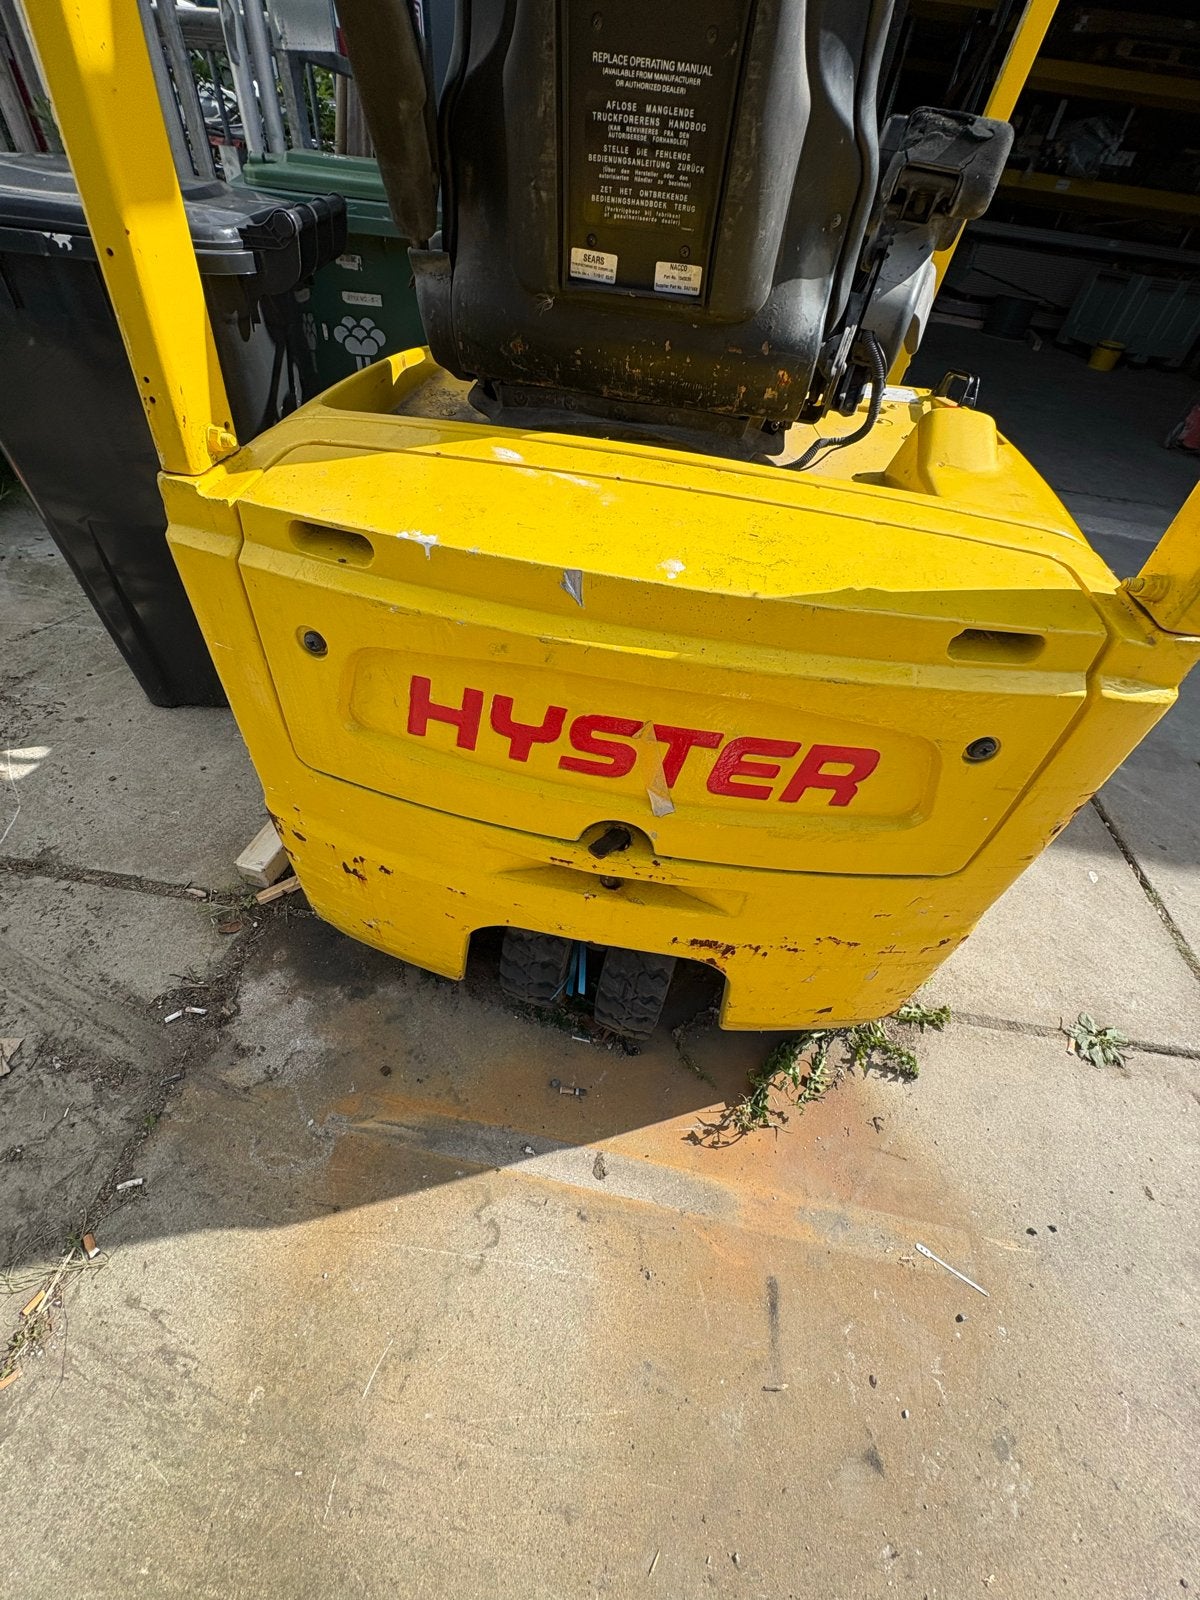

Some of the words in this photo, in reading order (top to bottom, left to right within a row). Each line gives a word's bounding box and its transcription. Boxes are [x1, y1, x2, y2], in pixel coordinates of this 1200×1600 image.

[593, 52, 628, 65] REPLACE
[630, 56, 675, 71] OPERATING
[677, 62, 713, 76] MANUAL
[602, 67, 635, 78] (AVAILABLE
[636, 70, 653, 80] FROM
[654, 73, 701, 86] MANUFACTURER
[625, 81, 661, 92] AUTHORIZED
[662, 85, 686, 94] DEALER)
[646, 104, 695, 118] MANGLENDE
[668, 119, 706, 132] HANDBOG
[603, 144, 629, 154] STELLE
[636, 148, 648, 156] DIE
[656, 150, 691, 161] FEHLENDE
[588, 154, 670, 169] BEDIENUNGSANLEITUNG
[678, 162, 705, 174] ZURÜCK
[600, 185, 612, 194] ZET
[620, 187, 632, 196] HET
[640, 189, 688, 202] ONTBREKENDE
[591, 194, 667, 209] BEDIENINGSHANDBOEK
[674, 203, 696, 213] TERUG
[583, 254, 605, 265] SEARS
[670, 264, 687, 272] NACCO
[407, 675, 880, 807] HYSTER
